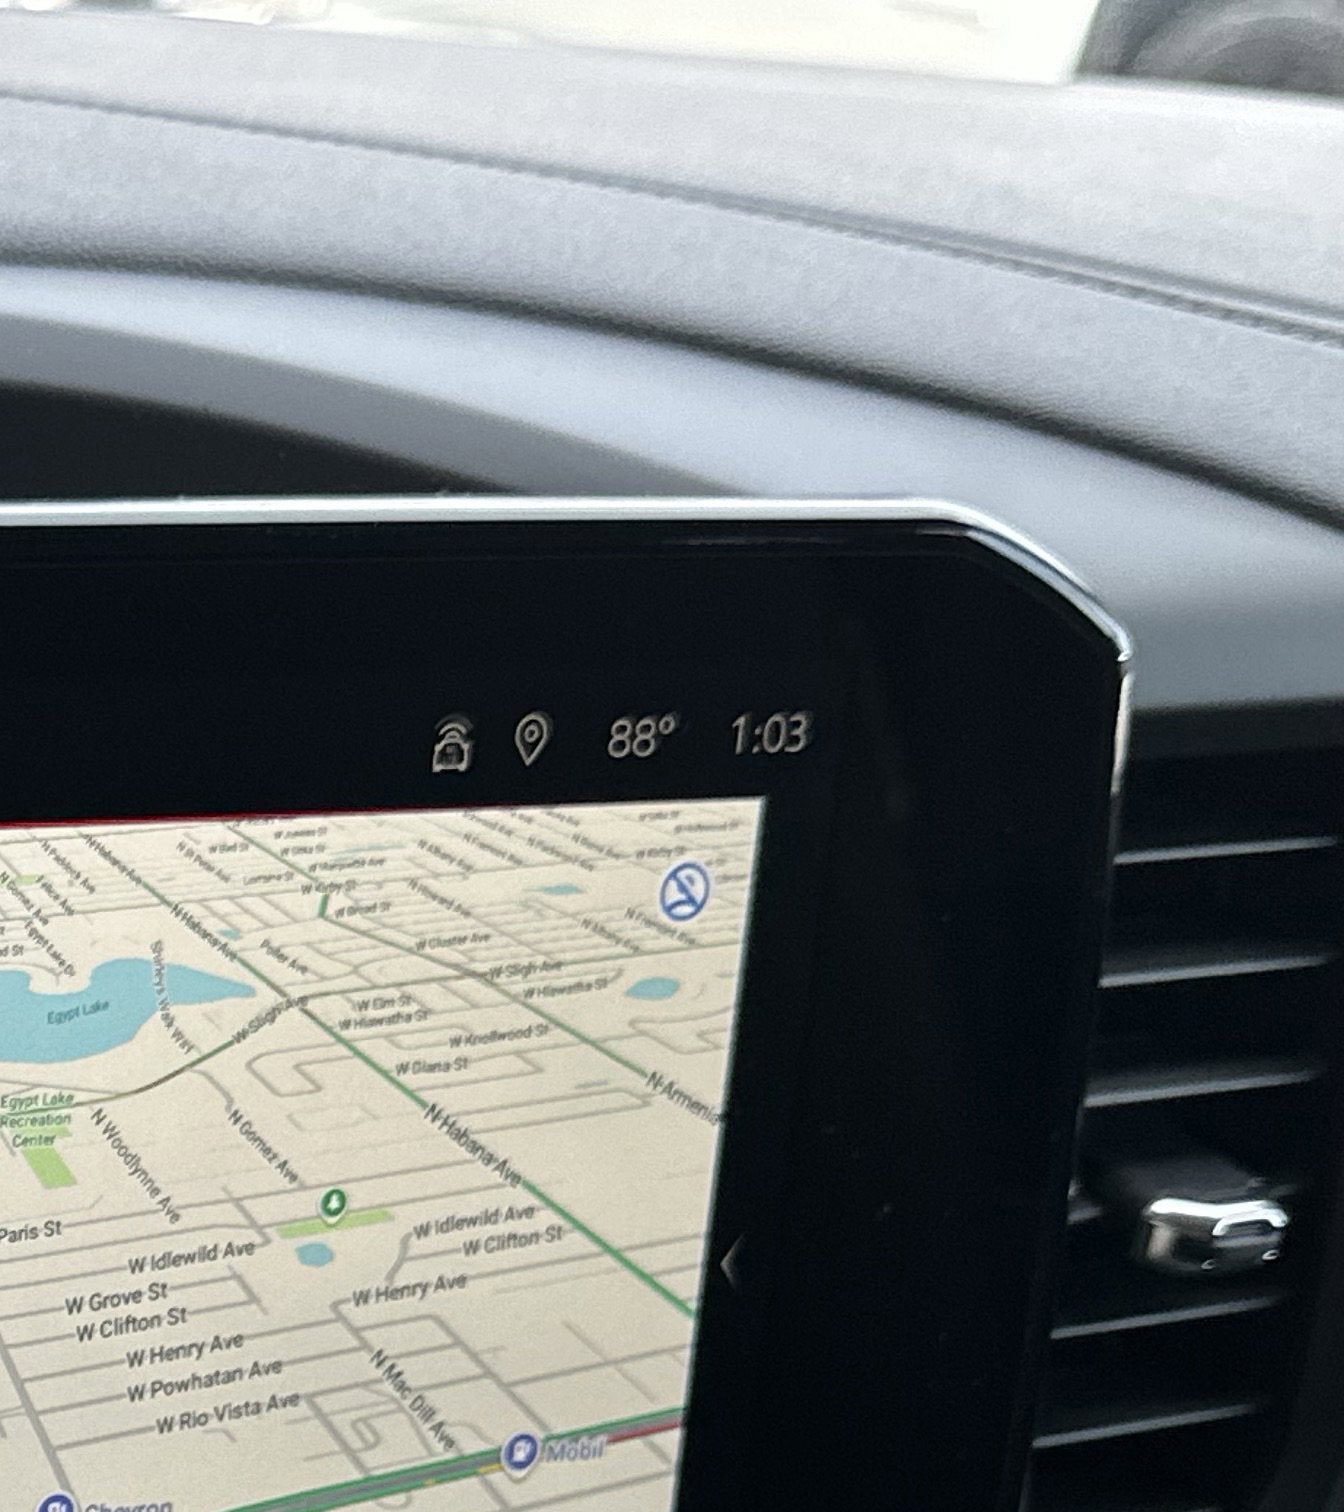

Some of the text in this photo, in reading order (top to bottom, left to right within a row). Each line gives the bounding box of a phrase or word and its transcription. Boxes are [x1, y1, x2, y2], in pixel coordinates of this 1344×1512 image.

[731, 713, 809, 754] 1:03
[47, 1000, 109, 1024] Egypt Lake
[0, 1092, 74, 1109] Egypt Lake
[0, 1113, 71, 1128] Recreation
[13, 1133, 56, 1147] Center
[424, 1103, 521, 1185] N Habana Ave
[90, 1108, 181, 1224] N Woodlynne Ave
[127, 1335, 244, 1368] W Henry Ave
[128, 1359, 282, 1401] W Powhatan Ave
[156, 1393, 300, 1433] W Rio Vista Ave
[369, 1349, 456, 1451] N Mac Dill Ave
[545, 1440, 604, 1462] Mobil
